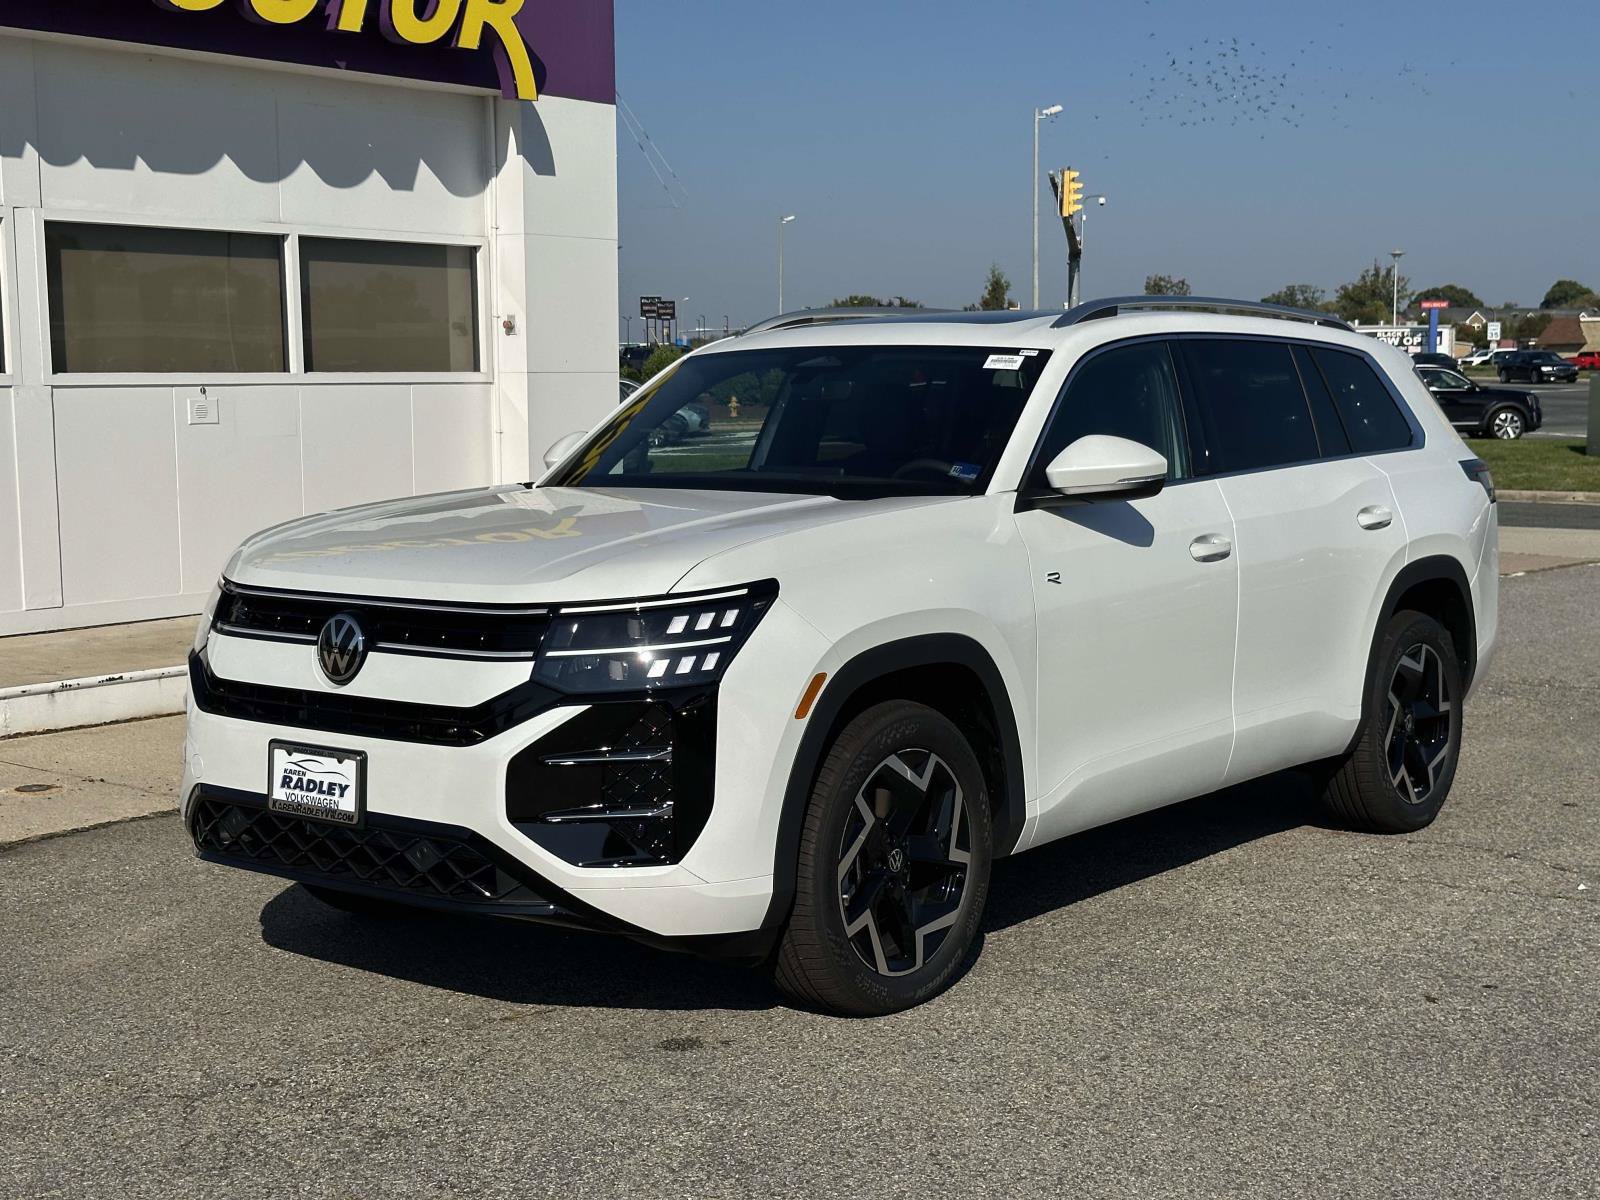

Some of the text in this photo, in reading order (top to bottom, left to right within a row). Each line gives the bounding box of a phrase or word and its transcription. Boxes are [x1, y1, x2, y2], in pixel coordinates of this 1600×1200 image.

[1047, 571, 1062, 585] R
[283, 768, 307, 778] KAREN
[280, 774, 351, 799] RADLEY
[285, 791, 340, 810] VOLKSWAGEN
